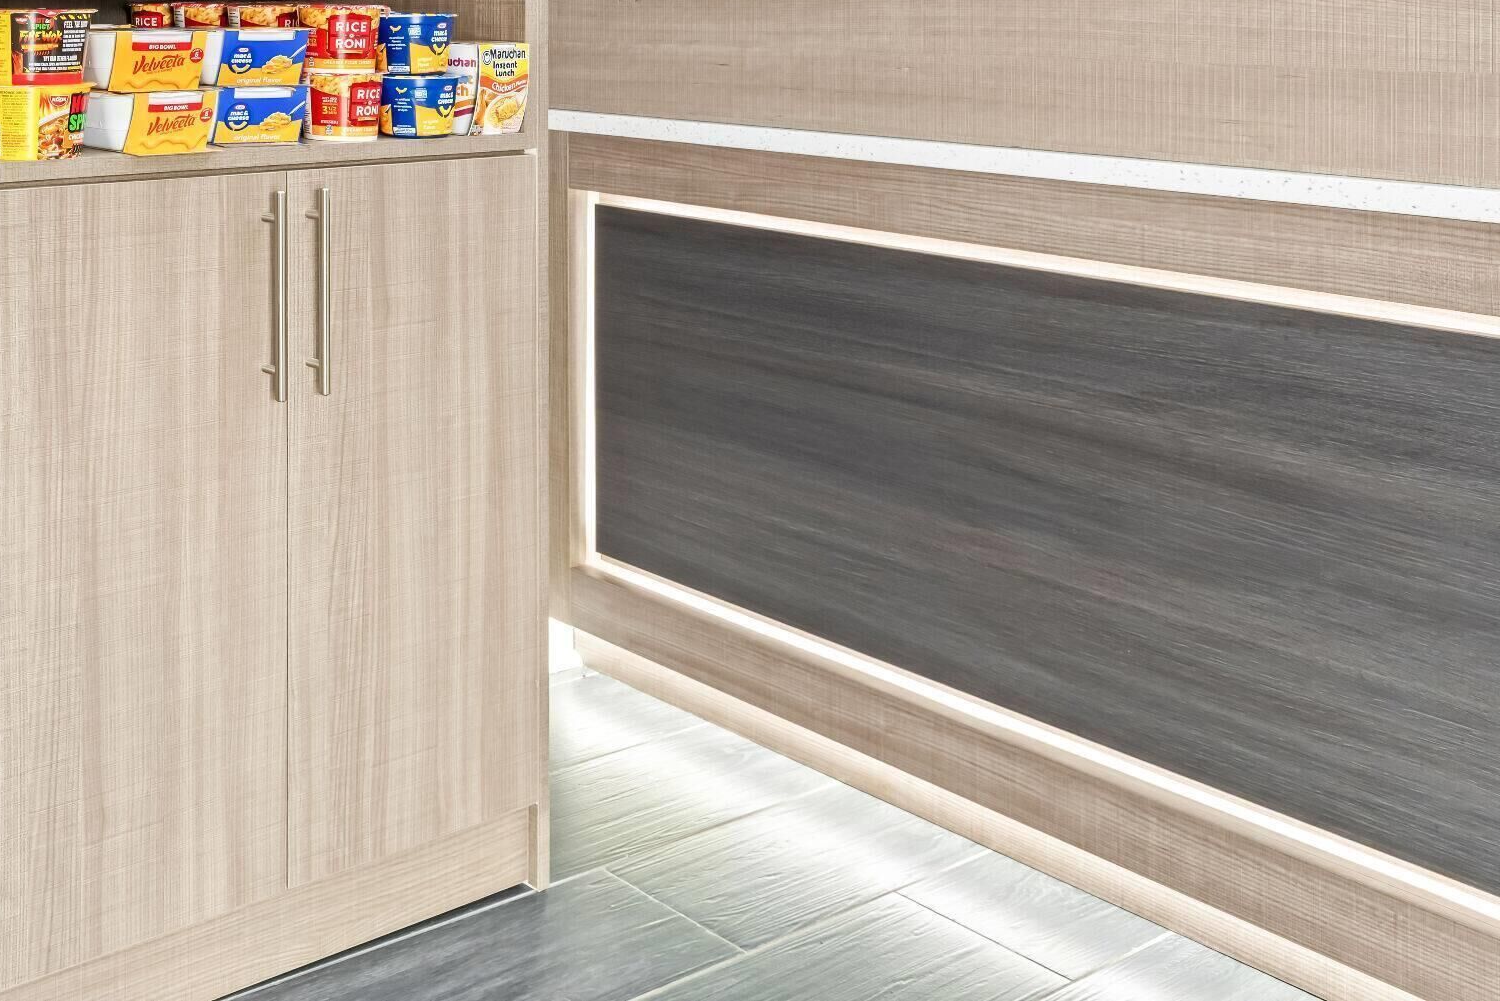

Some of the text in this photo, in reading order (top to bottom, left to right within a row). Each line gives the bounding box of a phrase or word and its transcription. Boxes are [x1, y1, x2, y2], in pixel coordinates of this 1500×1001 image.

[136, 17, 158, 27] RICE
[336, 21, 367, 33] RICE
[335, 38, 366, 49] RONI
[491, 48, 526, 60] Maruchan
[133, 54, 185, 75] Velveeta
[448, 57, 476, 67] uchan
[493, 61, 517, 69] Instant
[495, 69, 515, 77] Lunch
[492, 80, 516, 92] Chicken
[357, 88, 381, 100] RICE
[356, 105, 379, 116] RONI
[147, 112, 196, 137] Velveeta
